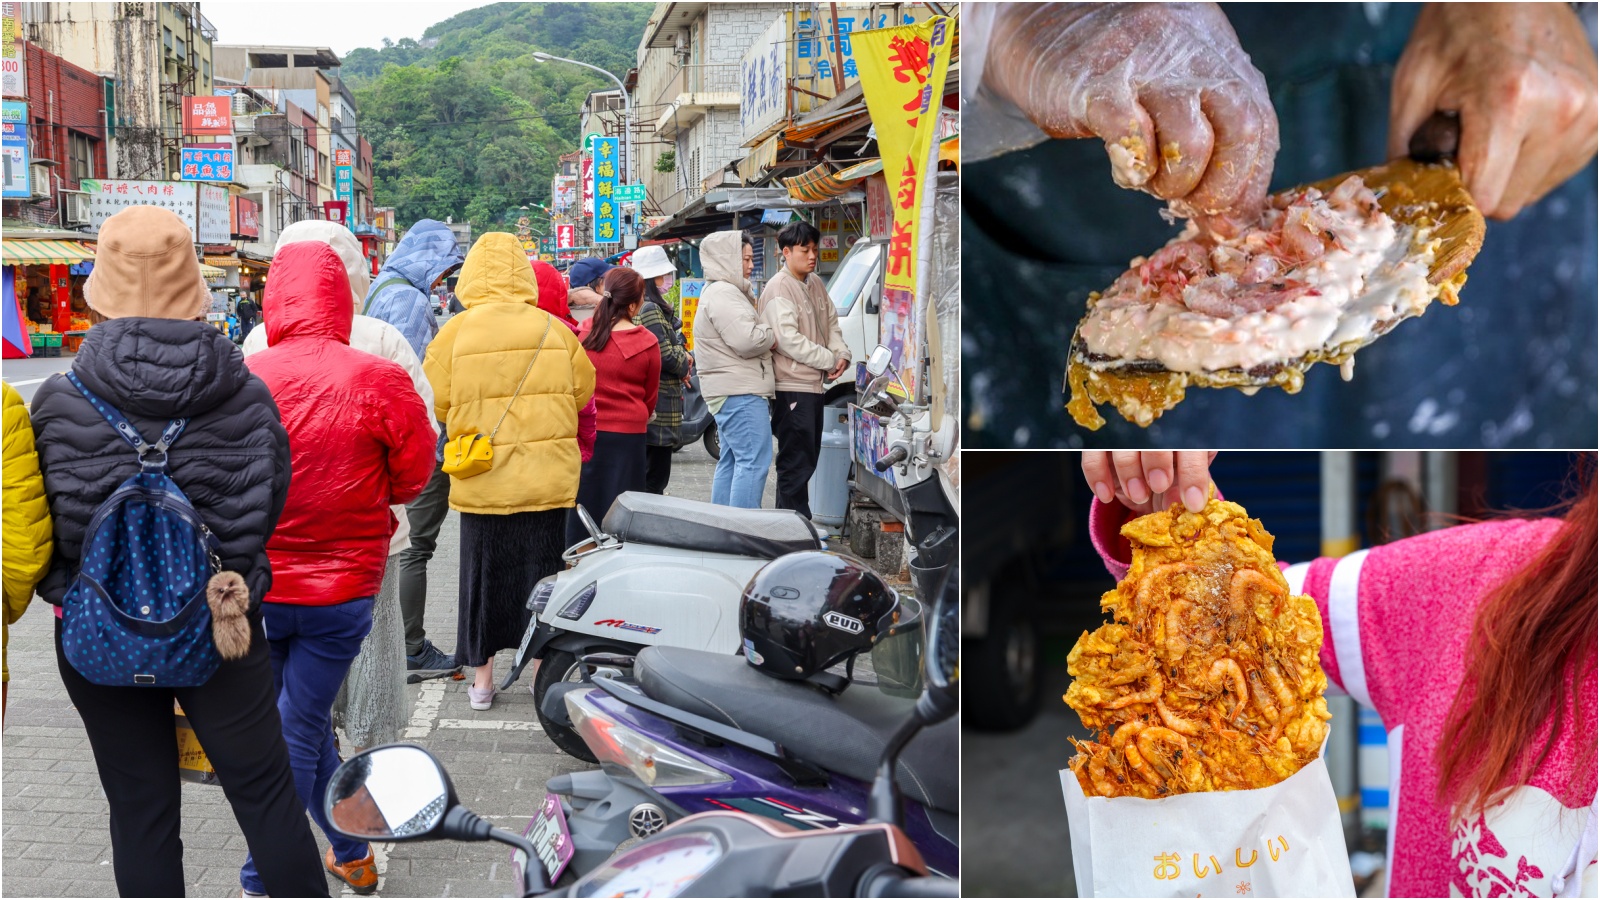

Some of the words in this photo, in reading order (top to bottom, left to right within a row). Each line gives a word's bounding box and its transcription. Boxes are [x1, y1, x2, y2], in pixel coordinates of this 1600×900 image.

[184, 163, 231, 178] 鮮魚湯
[337, 151, 350, 165] 藥
[598, 140, 615, 239] 幸福鮮魚湯
[1153, 834, 1290, 880] おいしい
